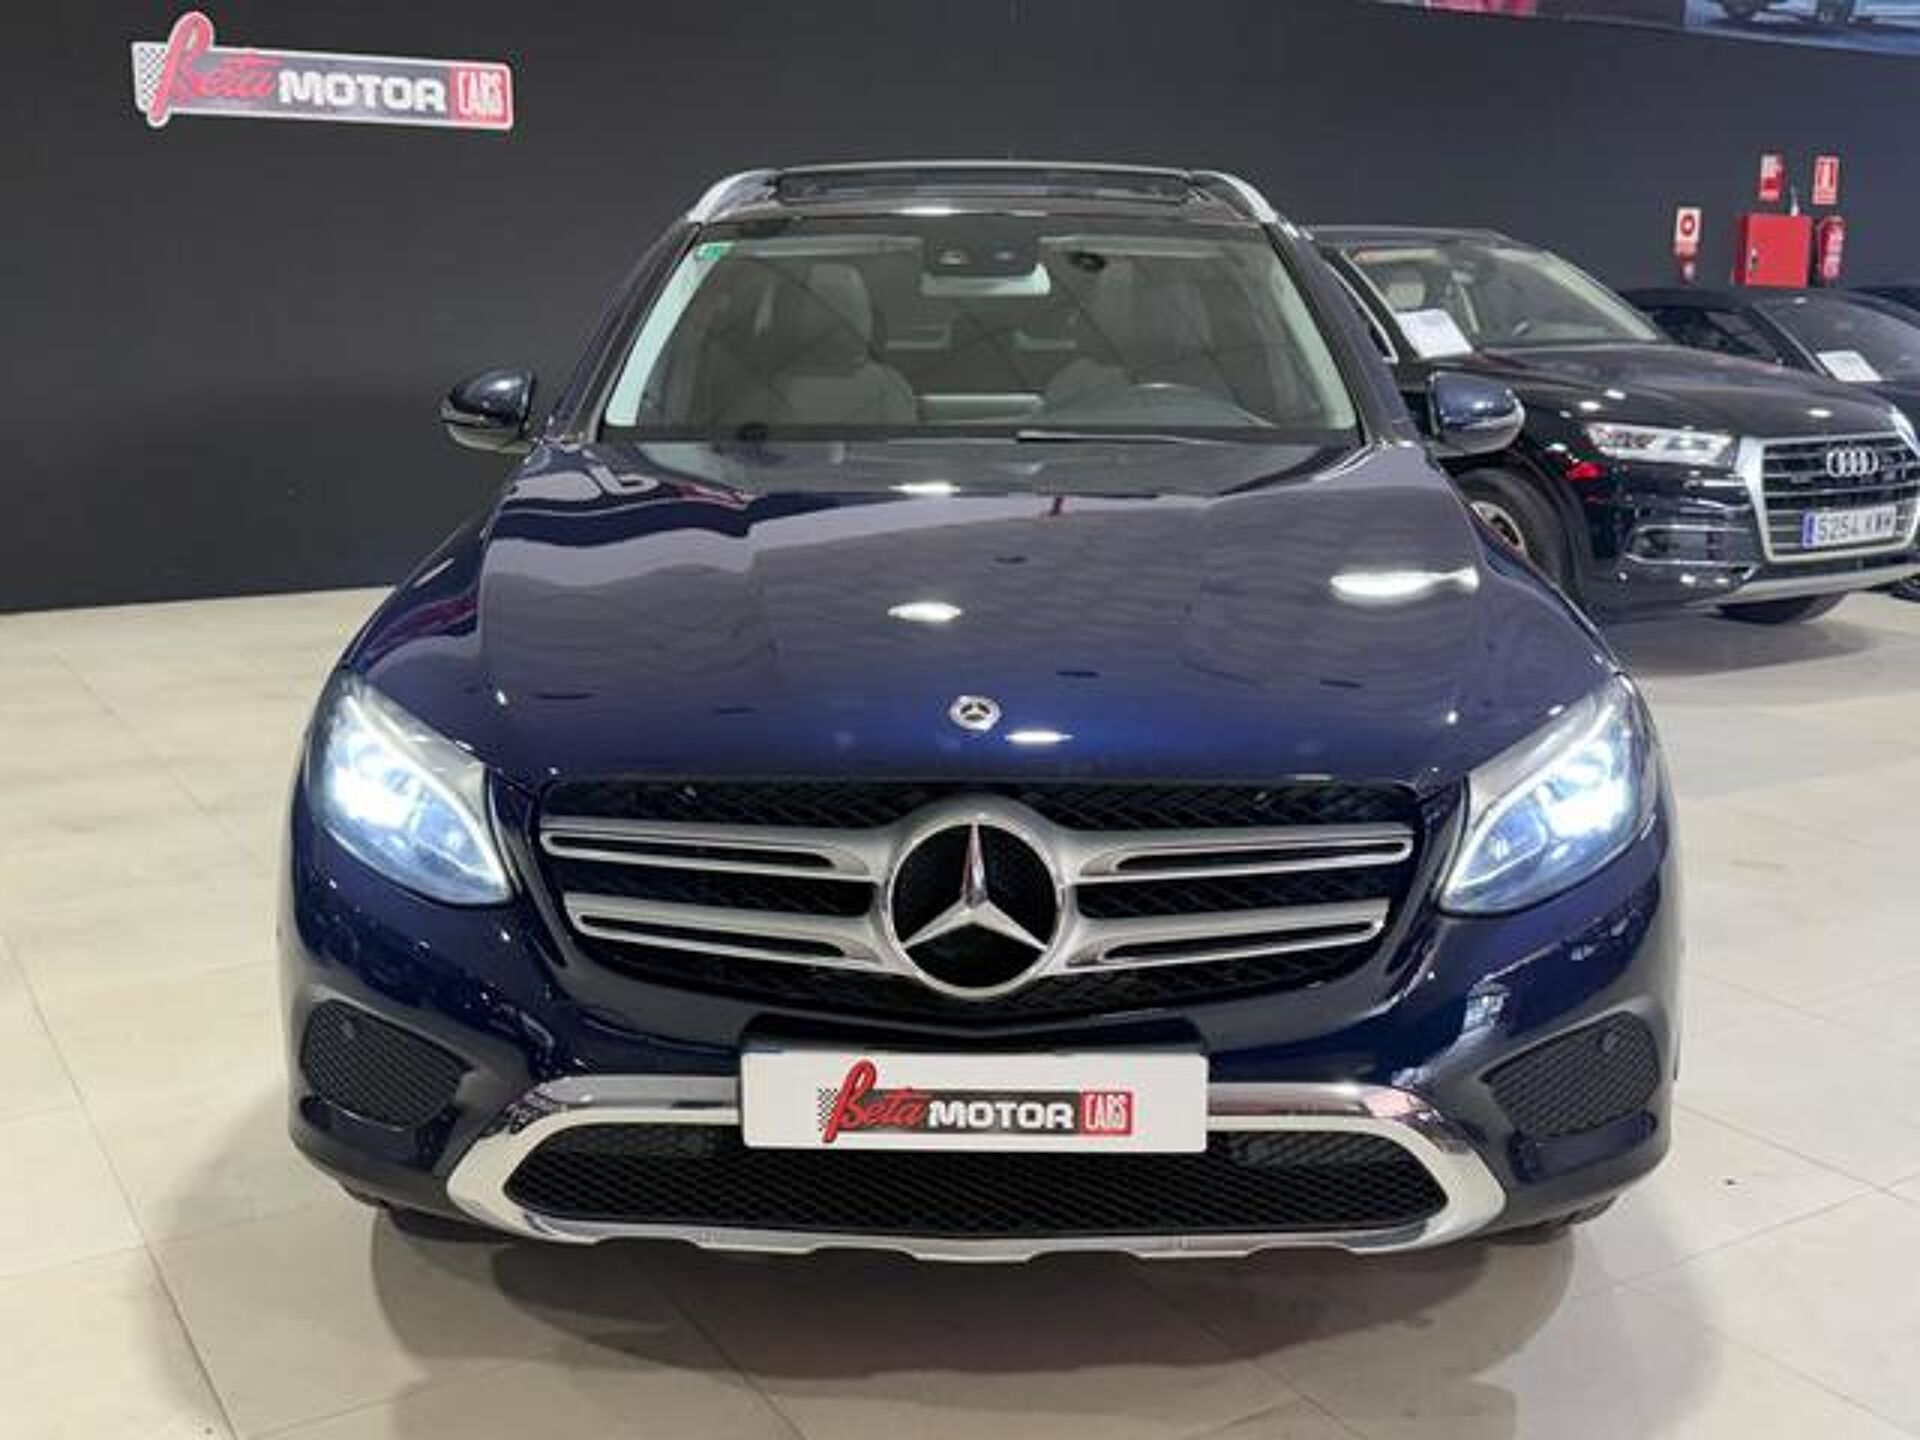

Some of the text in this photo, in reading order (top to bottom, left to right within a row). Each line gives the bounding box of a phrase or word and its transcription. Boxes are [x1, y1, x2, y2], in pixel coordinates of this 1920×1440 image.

[279, 70, 446, 112] MOTOR
[458, 69, 504, 116] CARS
[929, 1100, 1074, 1129] MOTOR
[1084, 1094, 1128, 1130] CARS
